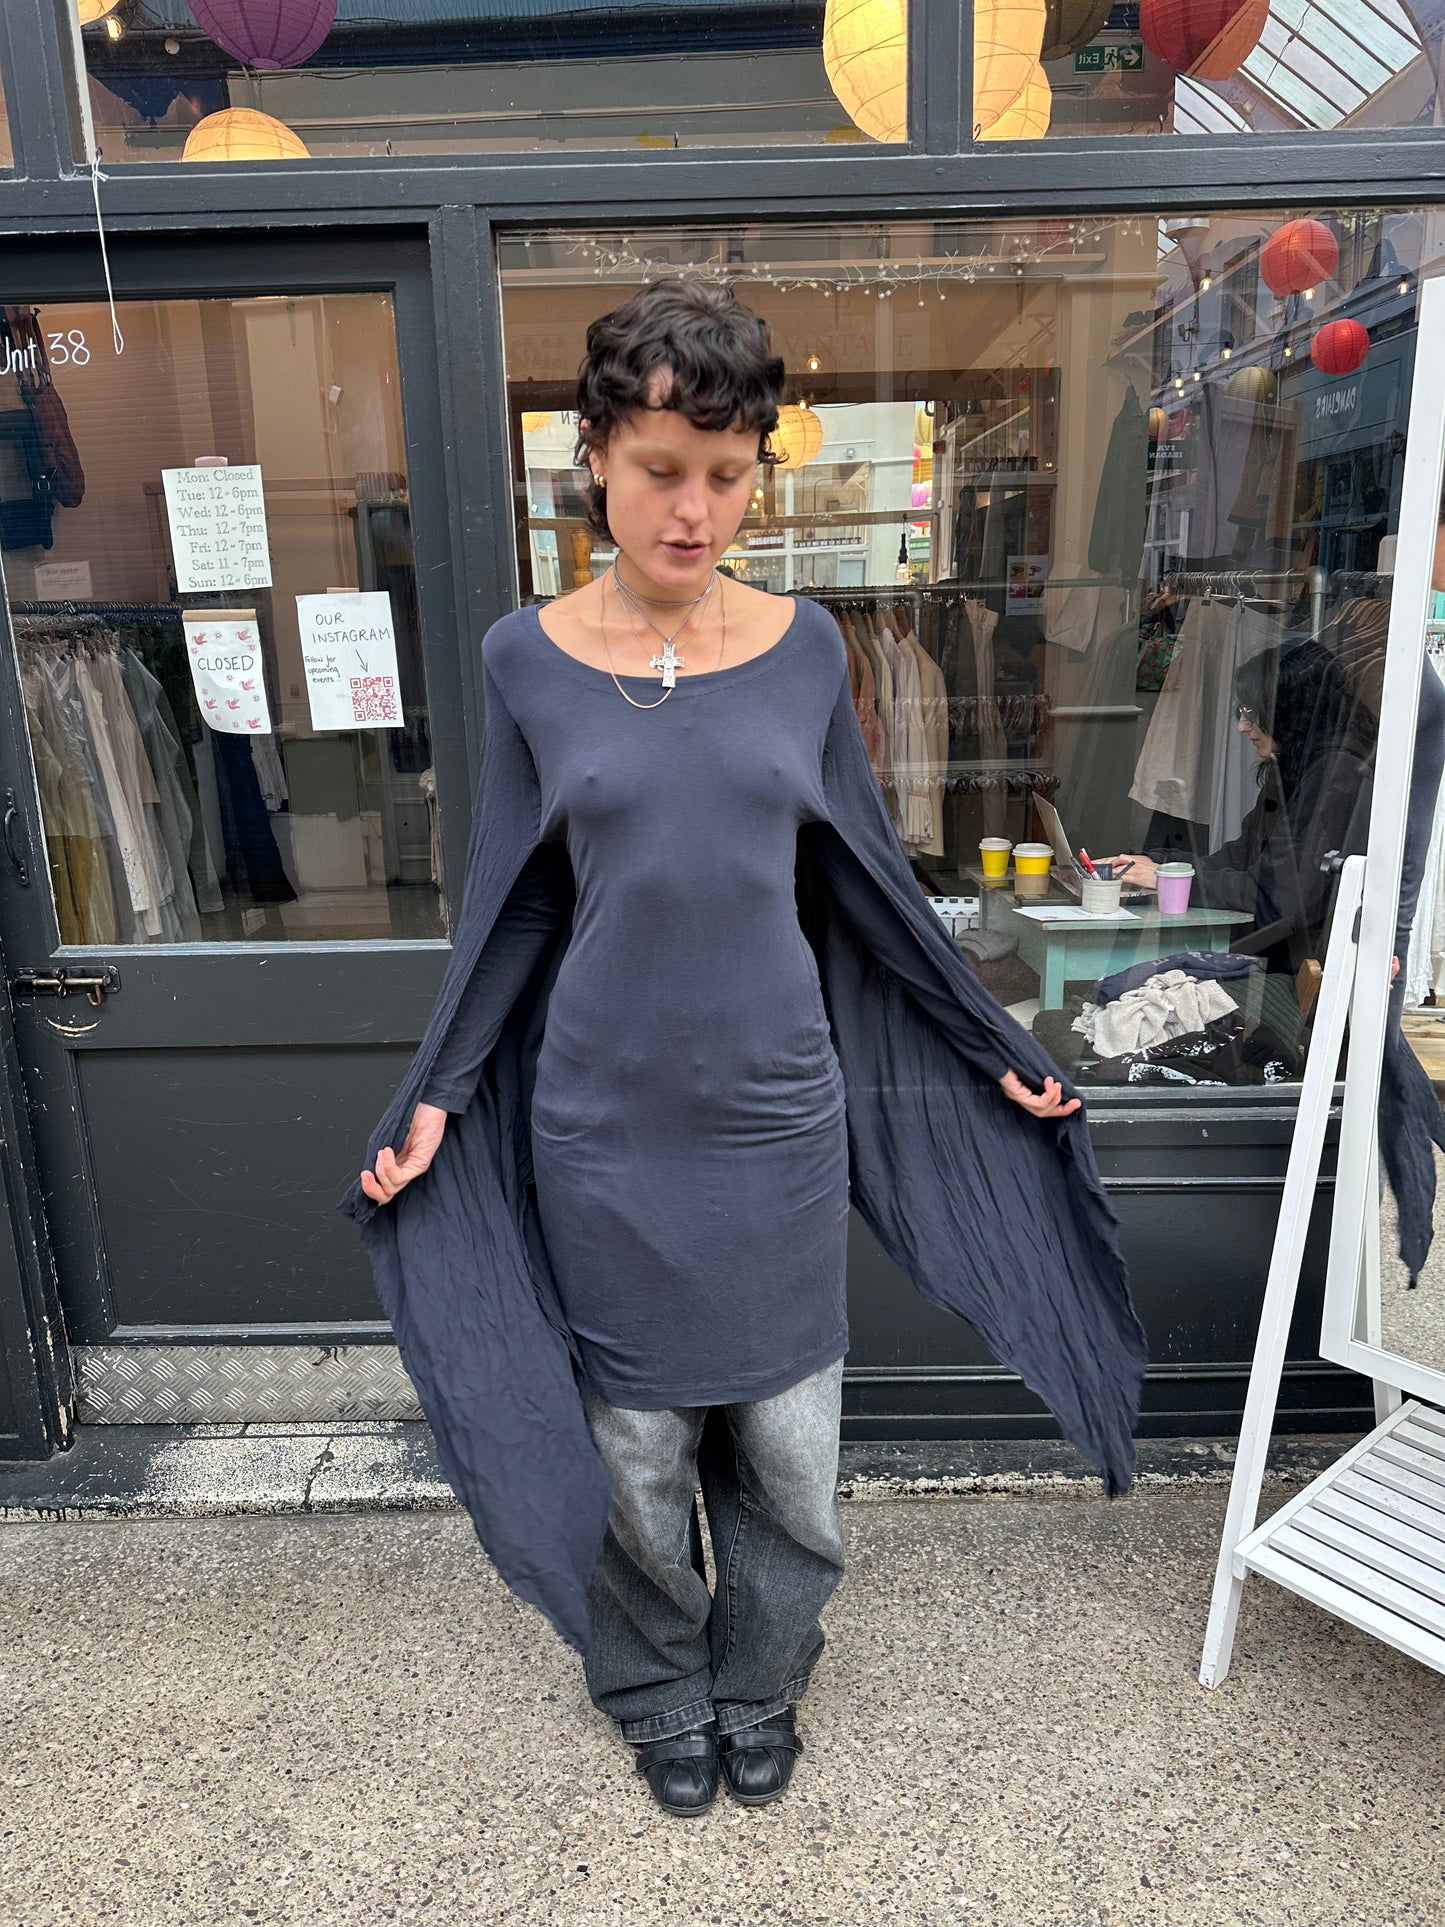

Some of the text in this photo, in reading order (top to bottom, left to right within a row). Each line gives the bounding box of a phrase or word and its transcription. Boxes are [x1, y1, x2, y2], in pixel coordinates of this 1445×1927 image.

[47, 329, 91, 366] 38
[784, 333, 913, 358] VINTAE
[176, 468, 254, 484] Mon: Closed
[176, 489, 206, 501] Tue:
[176, 506, 212, 519] Wed:
[176, 524, 208, 537] Thu:
[189, 541, 212, 554] Fri:
[191, 559, 215, 571] Sat:
[188, 576, 217, 588] Sun:
[315, 612, 345, 626] OUR
[312, 627, 391, 644] INSTAGRAM
[197, 655, 254, 671] CLOSED
[304, 655, 337, 668] Follow for
[307, 666, 341, 678] upcoming
